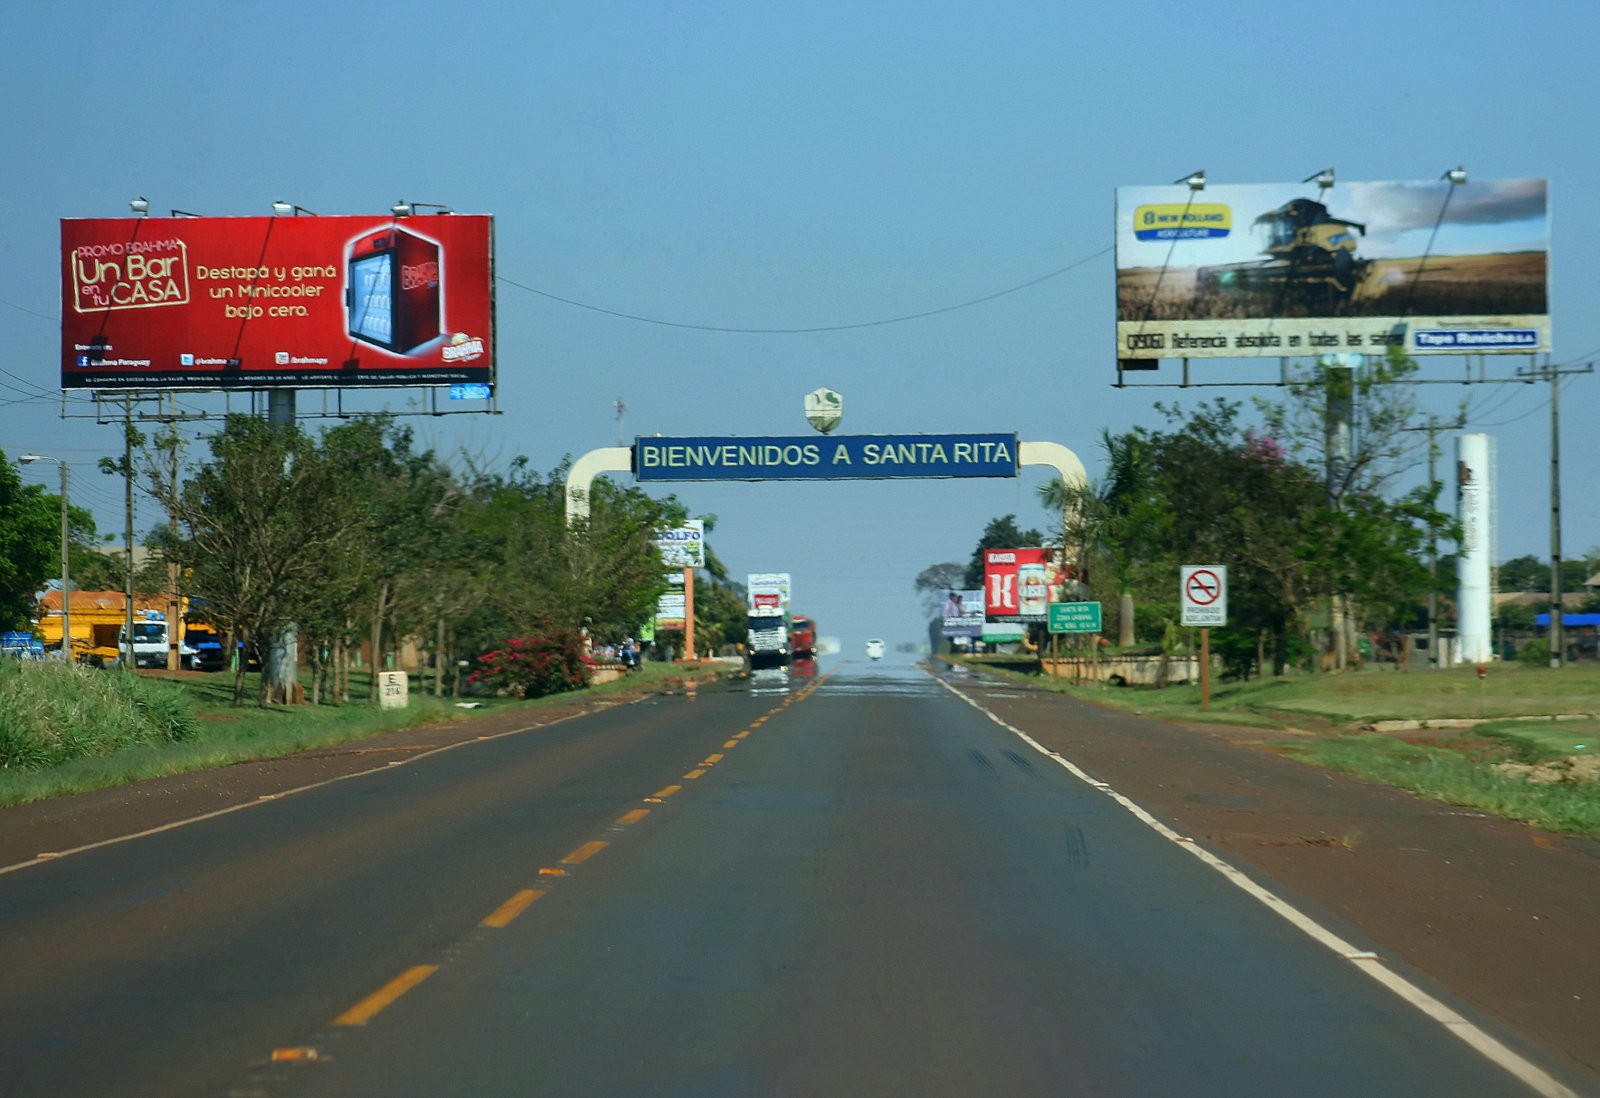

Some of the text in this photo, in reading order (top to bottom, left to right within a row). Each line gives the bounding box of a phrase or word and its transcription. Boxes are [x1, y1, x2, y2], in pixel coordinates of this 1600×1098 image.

[77, 239, 178, 257] PROMO BRAHMA
[79, 255, 179, 284] Un Bar
[196, 264, 337, 281] Destapá y ganá
[82, 278, 181, 306] en tu CASA
[209, 284, 324, 298] un Minicooler
[225, 304, 309, 320] bajo cero.
[1171, 332, 1227, 349] Referencia
[1235, 331, 1281, 348] absoluta
[1288, 335, 1301, 347] en
[1308, 330, 1339, 347] todas
[643, 442, 1012, 467] BIENVENIDOS A SANTA RITA
[388, 674, 396, 684] E
